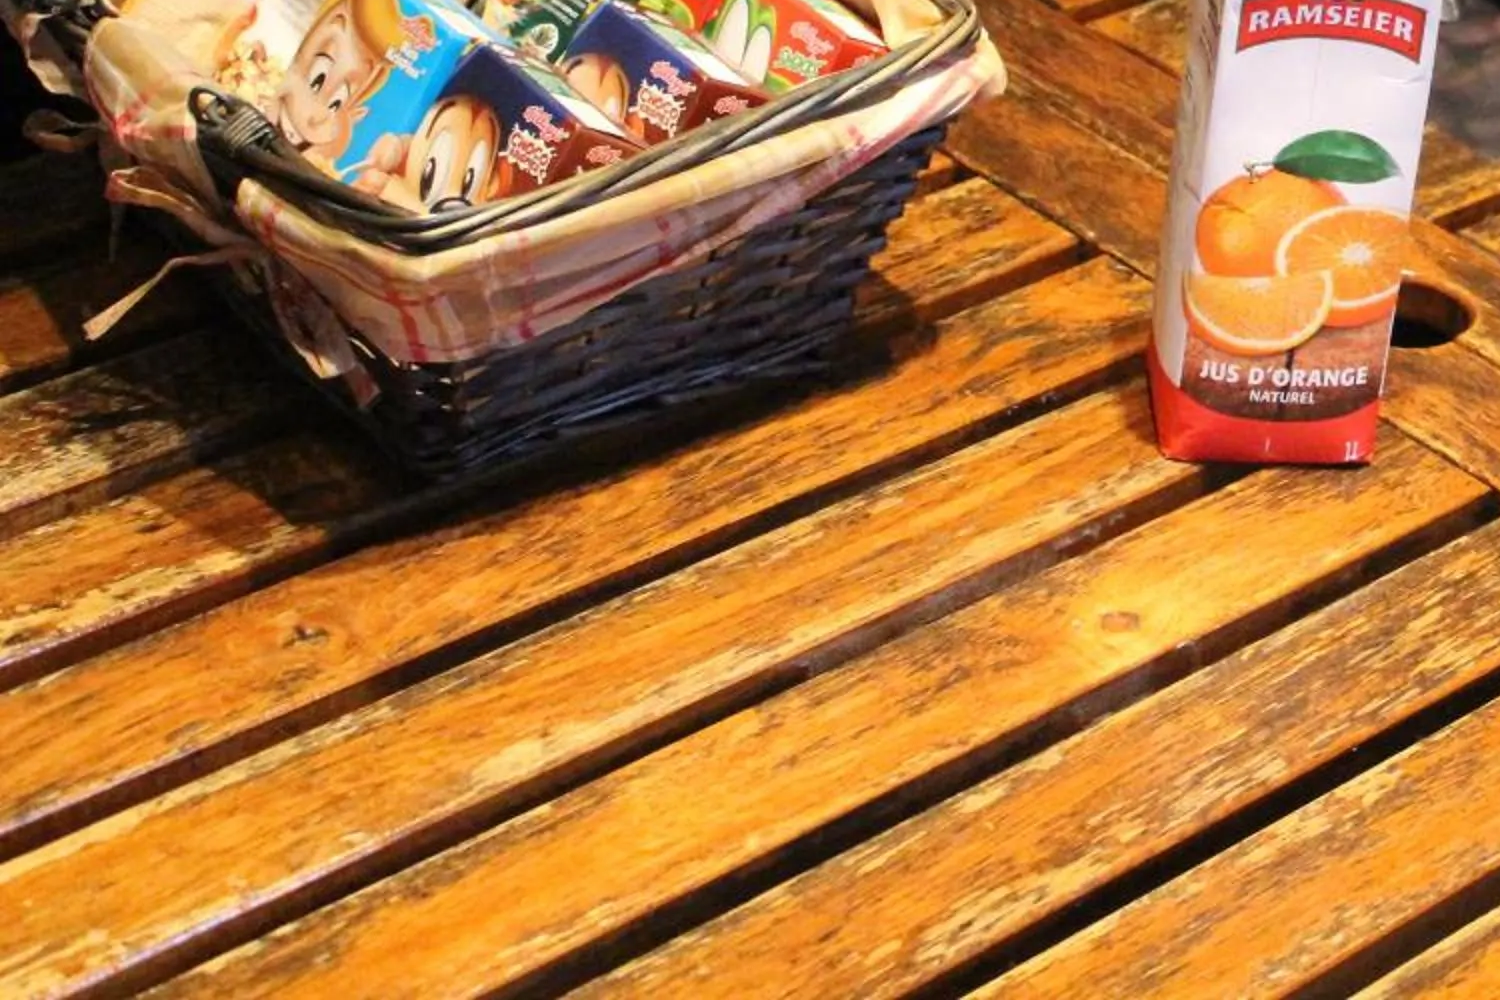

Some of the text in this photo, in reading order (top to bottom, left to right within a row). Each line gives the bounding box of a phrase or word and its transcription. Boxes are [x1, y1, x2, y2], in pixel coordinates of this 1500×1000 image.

[1248, 3, 1413, 42] RAMSEIER
[1200, 360, 1369, 388] JUS D'ORANGE
[1249, 389, 1314, 405] NATUREL
